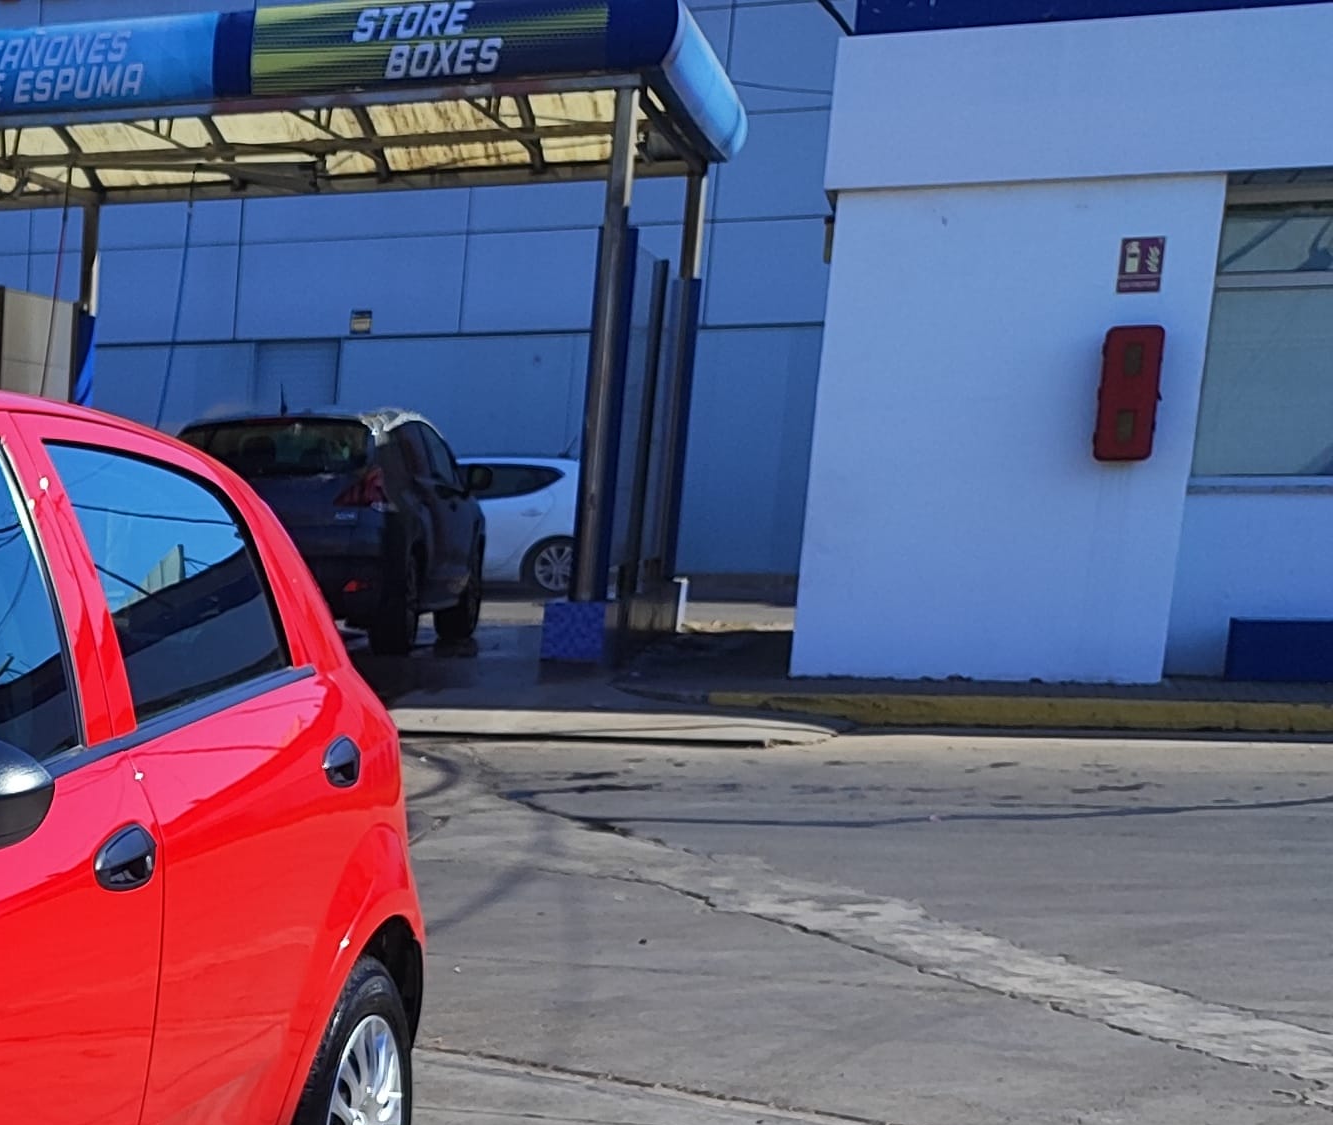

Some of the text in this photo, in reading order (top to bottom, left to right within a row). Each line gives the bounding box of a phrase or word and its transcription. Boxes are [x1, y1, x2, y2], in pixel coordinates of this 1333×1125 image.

[352, 1, 474, 42] STORE
[384, 38, 503, 79] BOXES
[13, 63, 144, 104] ESPUMA
